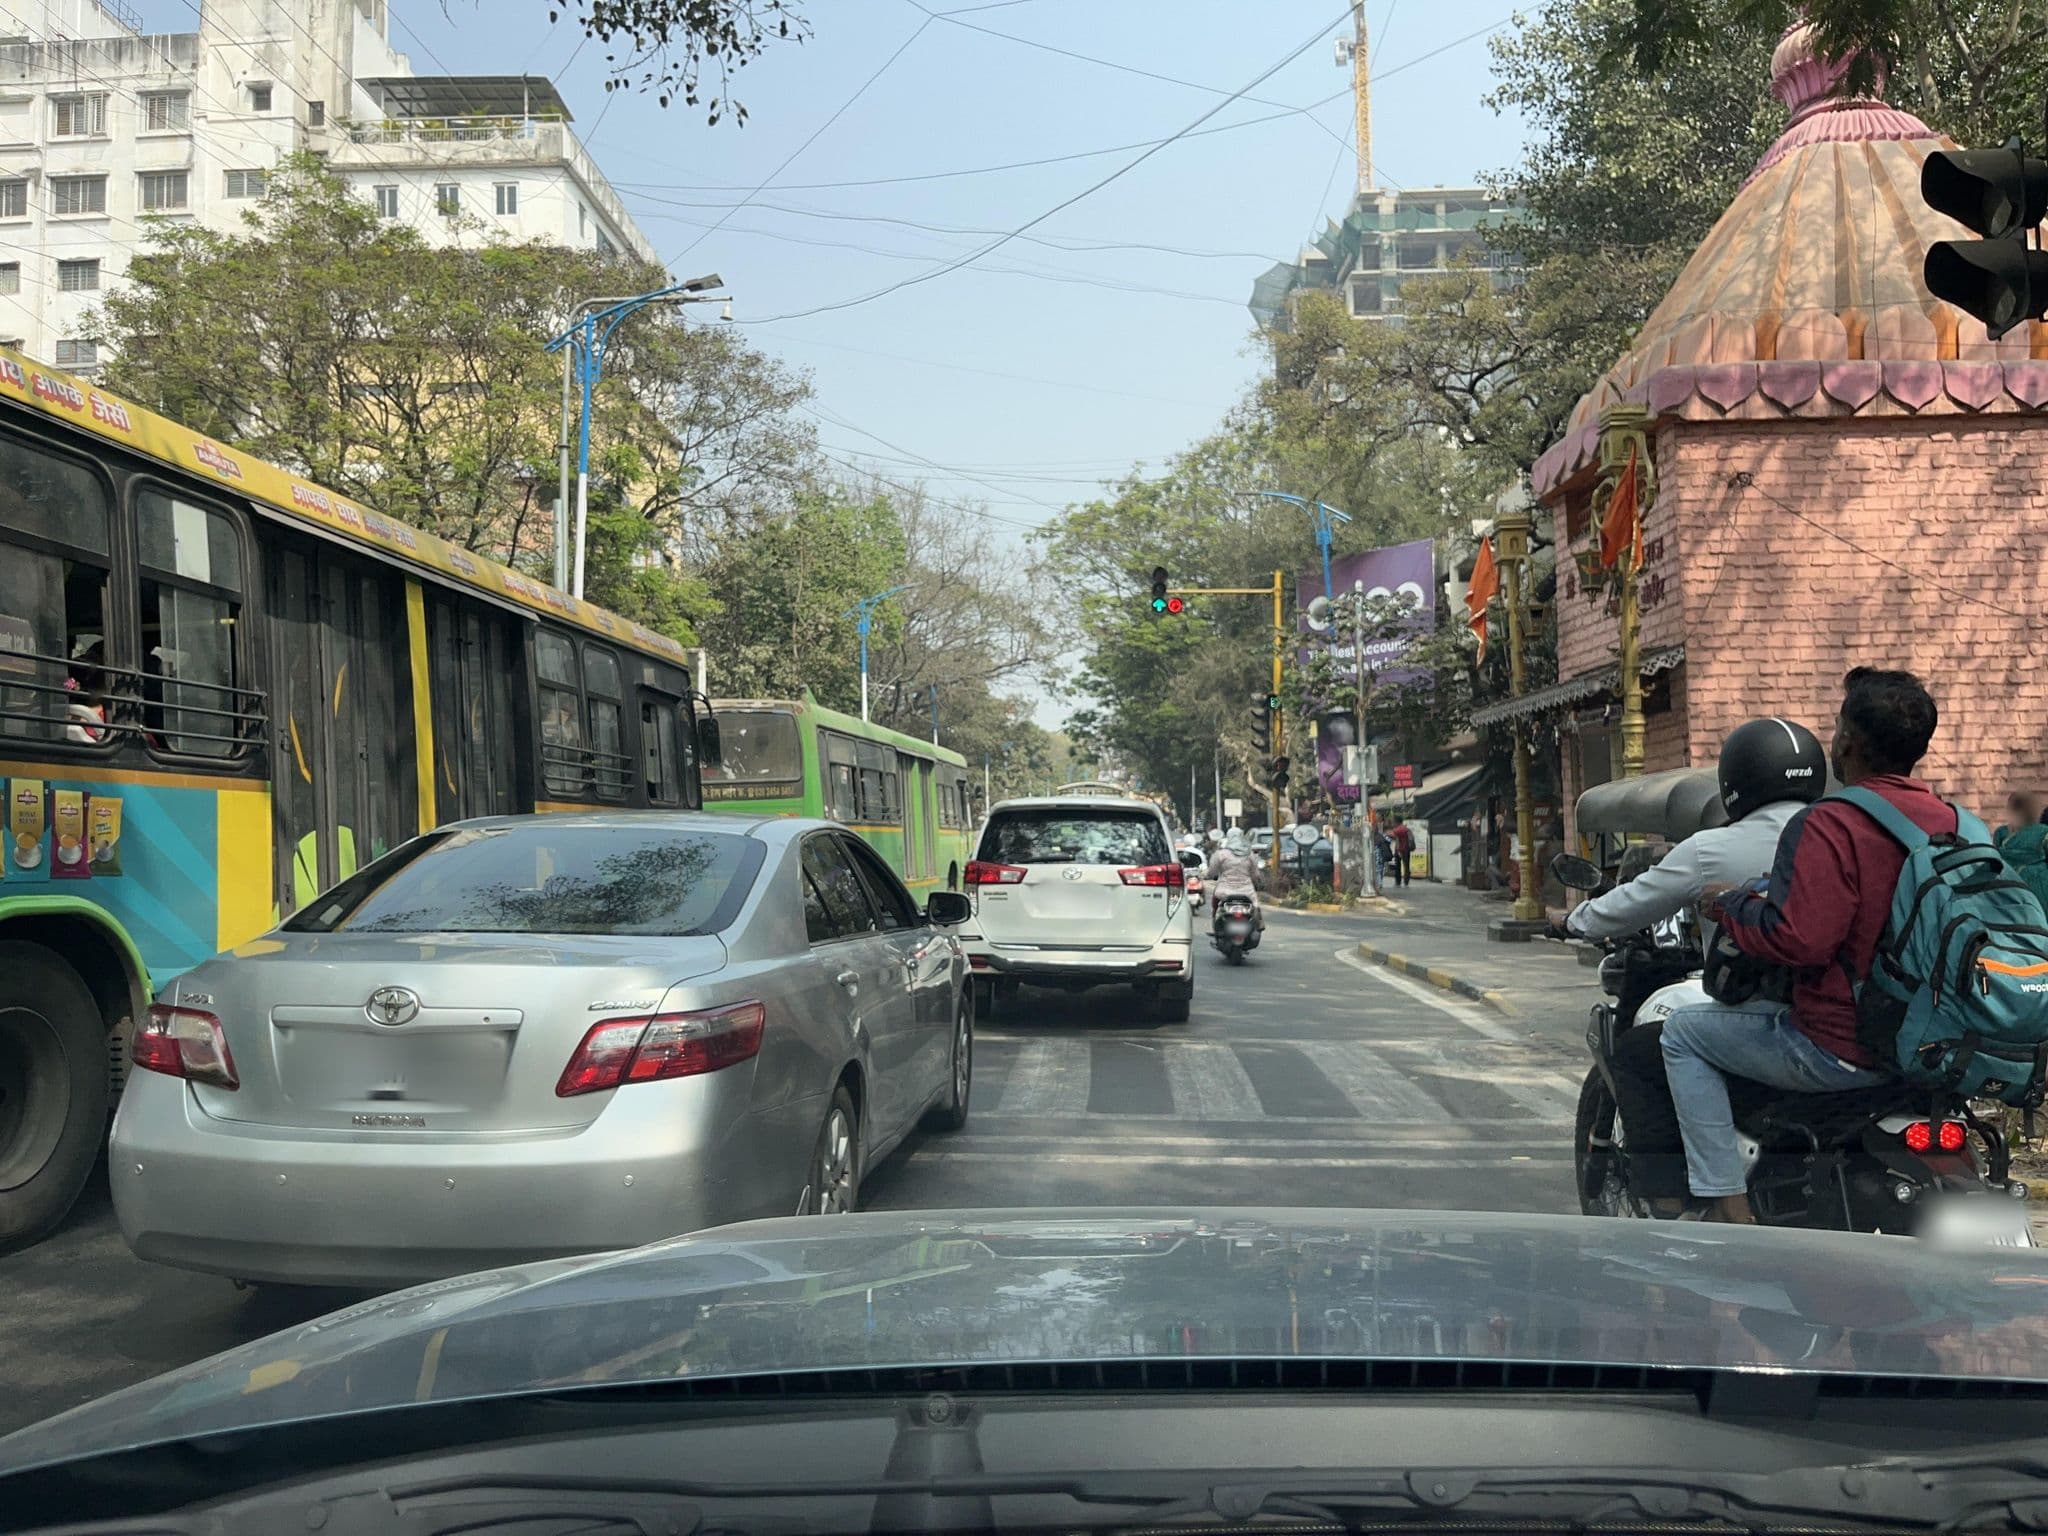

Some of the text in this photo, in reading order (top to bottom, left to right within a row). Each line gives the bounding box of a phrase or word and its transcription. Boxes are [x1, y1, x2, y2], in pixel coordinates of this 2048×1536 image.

[31, 371, 84, 411] आपके
[89, 391, 131, 432] जैसी
[1785, 766, 1813, 780] yezdi
[587, 999, 658, 1012] CAMRY
